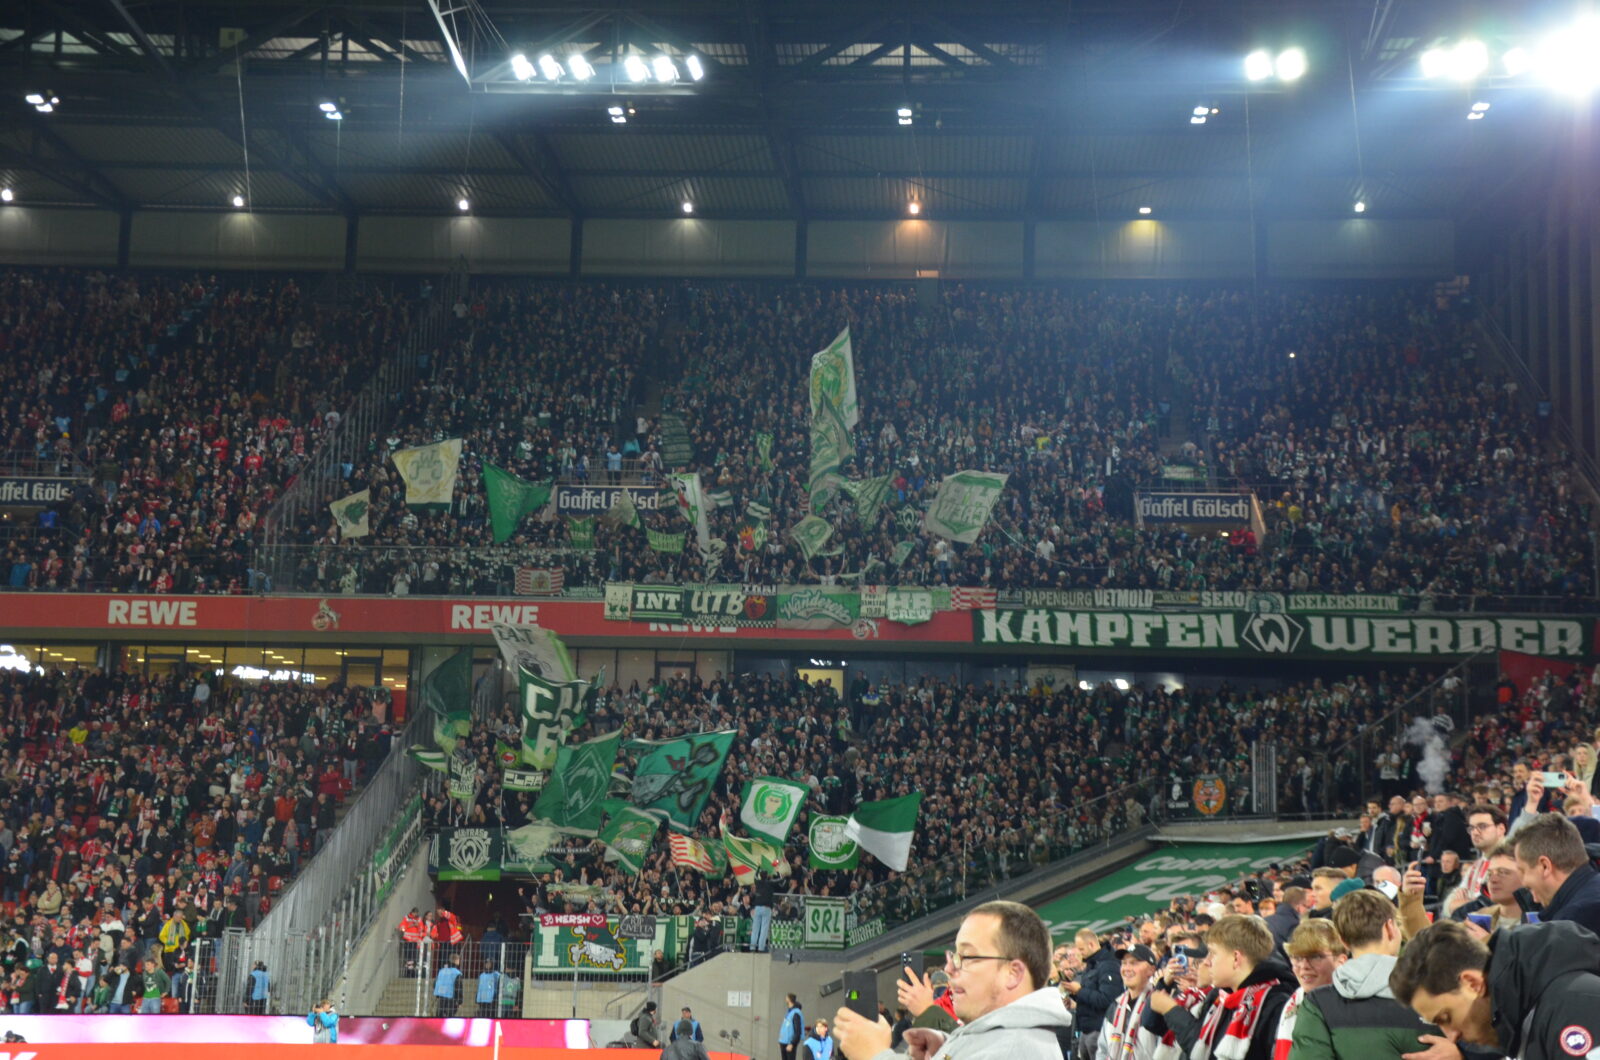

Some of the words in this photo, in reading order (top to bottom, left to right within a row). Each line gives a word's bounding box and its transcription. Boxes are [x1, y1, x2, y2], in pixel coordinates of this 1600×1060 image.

[0, 482, 28, 501] ffel
[32, 482, 69, 501] Köls
[560, 489, 607, 511] Gaffel
[1140, 497, 1189, 517] Gaffel
[1192, 498, 1249, 518] Kölsch
[635, 592, 681, 611] INT
[690, 590, 747, 616] UTB
[1025, 590, 1092, 606] PAPENBURG
[1289, 594, 1399, 611] ISELERSHEIM
[108, 600, 197, 625] REWE
[451, 604, 539, 630] REWE
[980, 609, 1239, 648] KÄMPFEN
[1306, 616, 1583, 656] WERDER
[1134, 856, 1251, 871] Come
[1094, 875, 1227, 902] FC
[555, 914, 591, 925] HERSH
[810, 908, 840, 933] SRL
